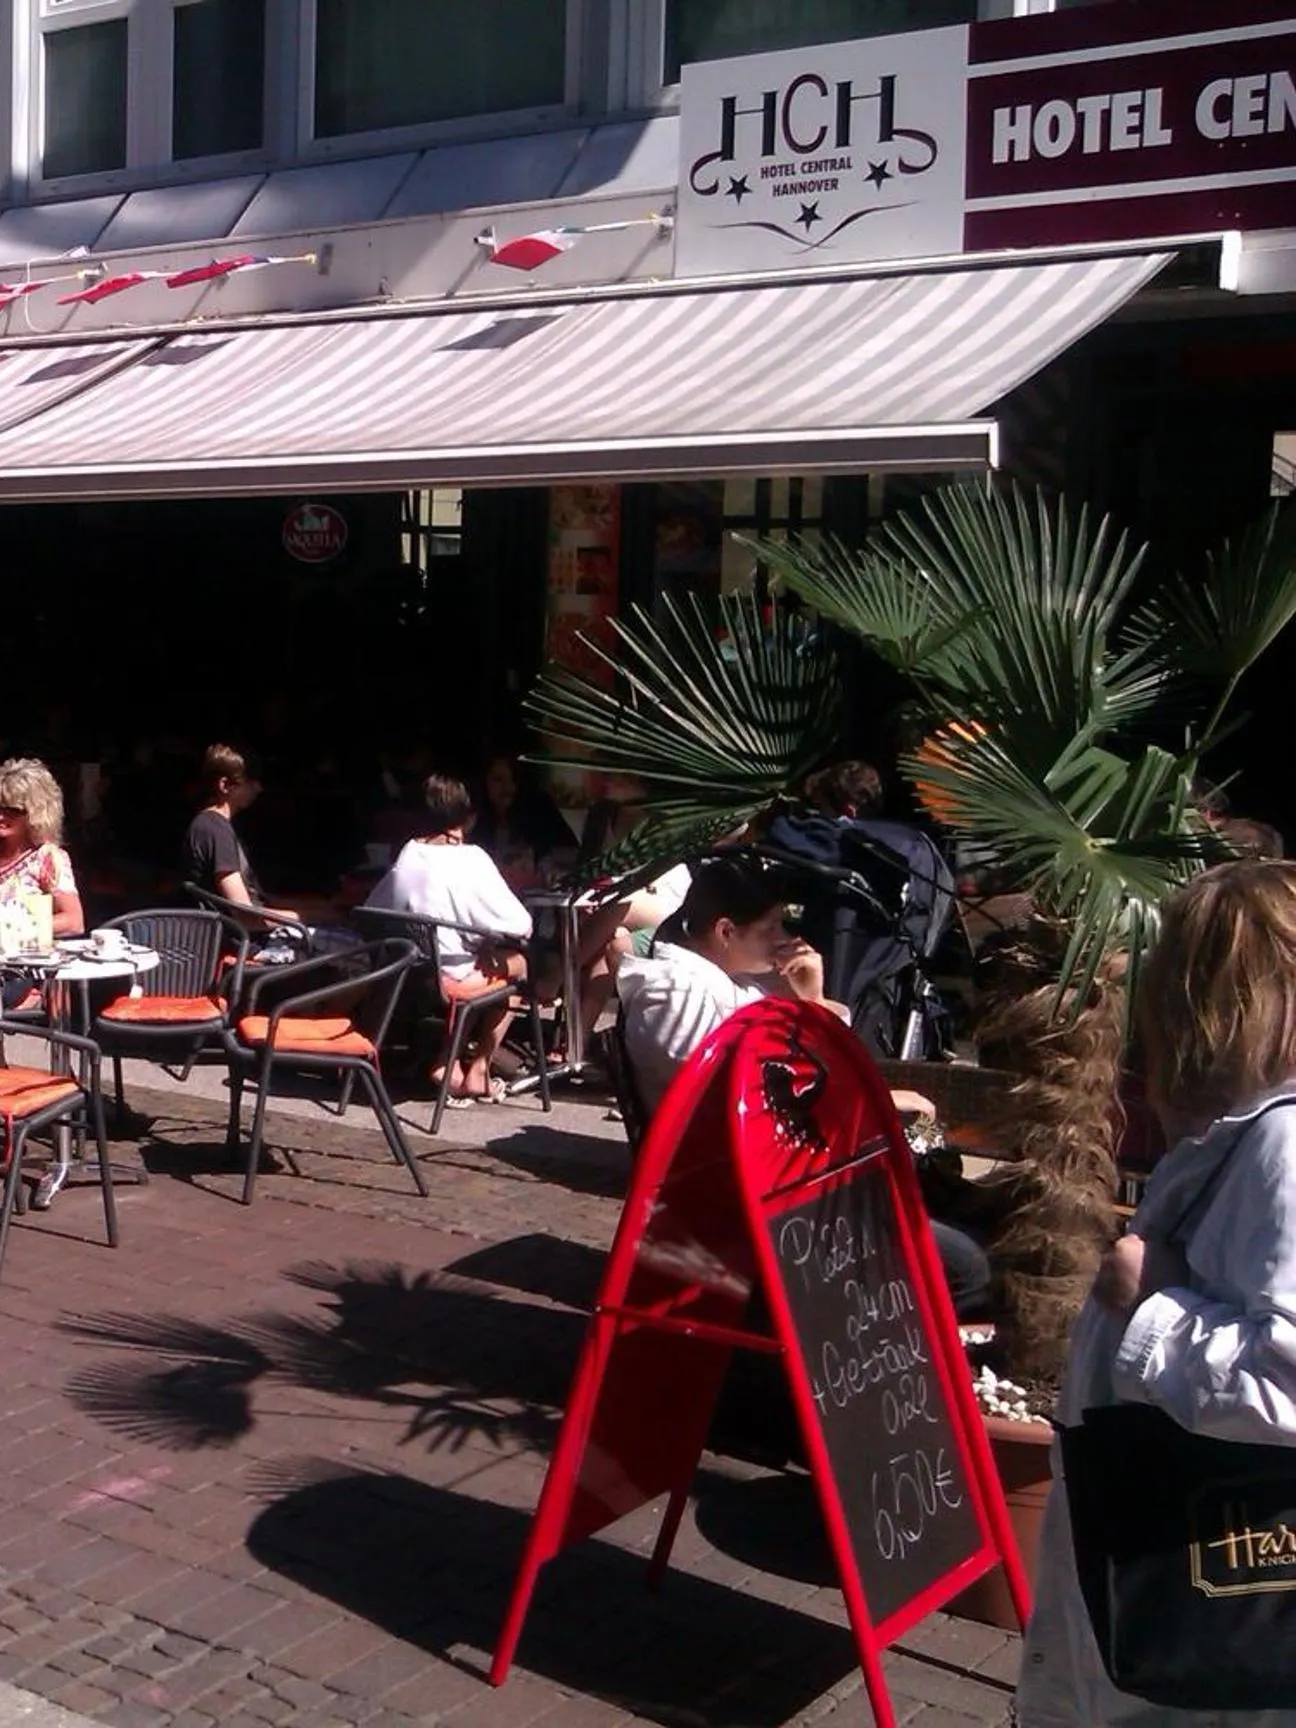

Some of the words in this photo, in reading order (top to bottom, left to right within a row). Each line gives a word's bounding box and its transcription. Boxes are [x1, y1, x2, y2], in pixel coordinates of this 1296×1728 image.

[696, 74, 930, 182] HCH
[992, 87, 1172, 164] HOTEL
[760, 164, 796, 179] HOTEL
[800, 156, 853, 175] CENTRAL
[771, 177, 839, 197] HANNOVER
[872, 1447, 963, 1560] 6,50€
